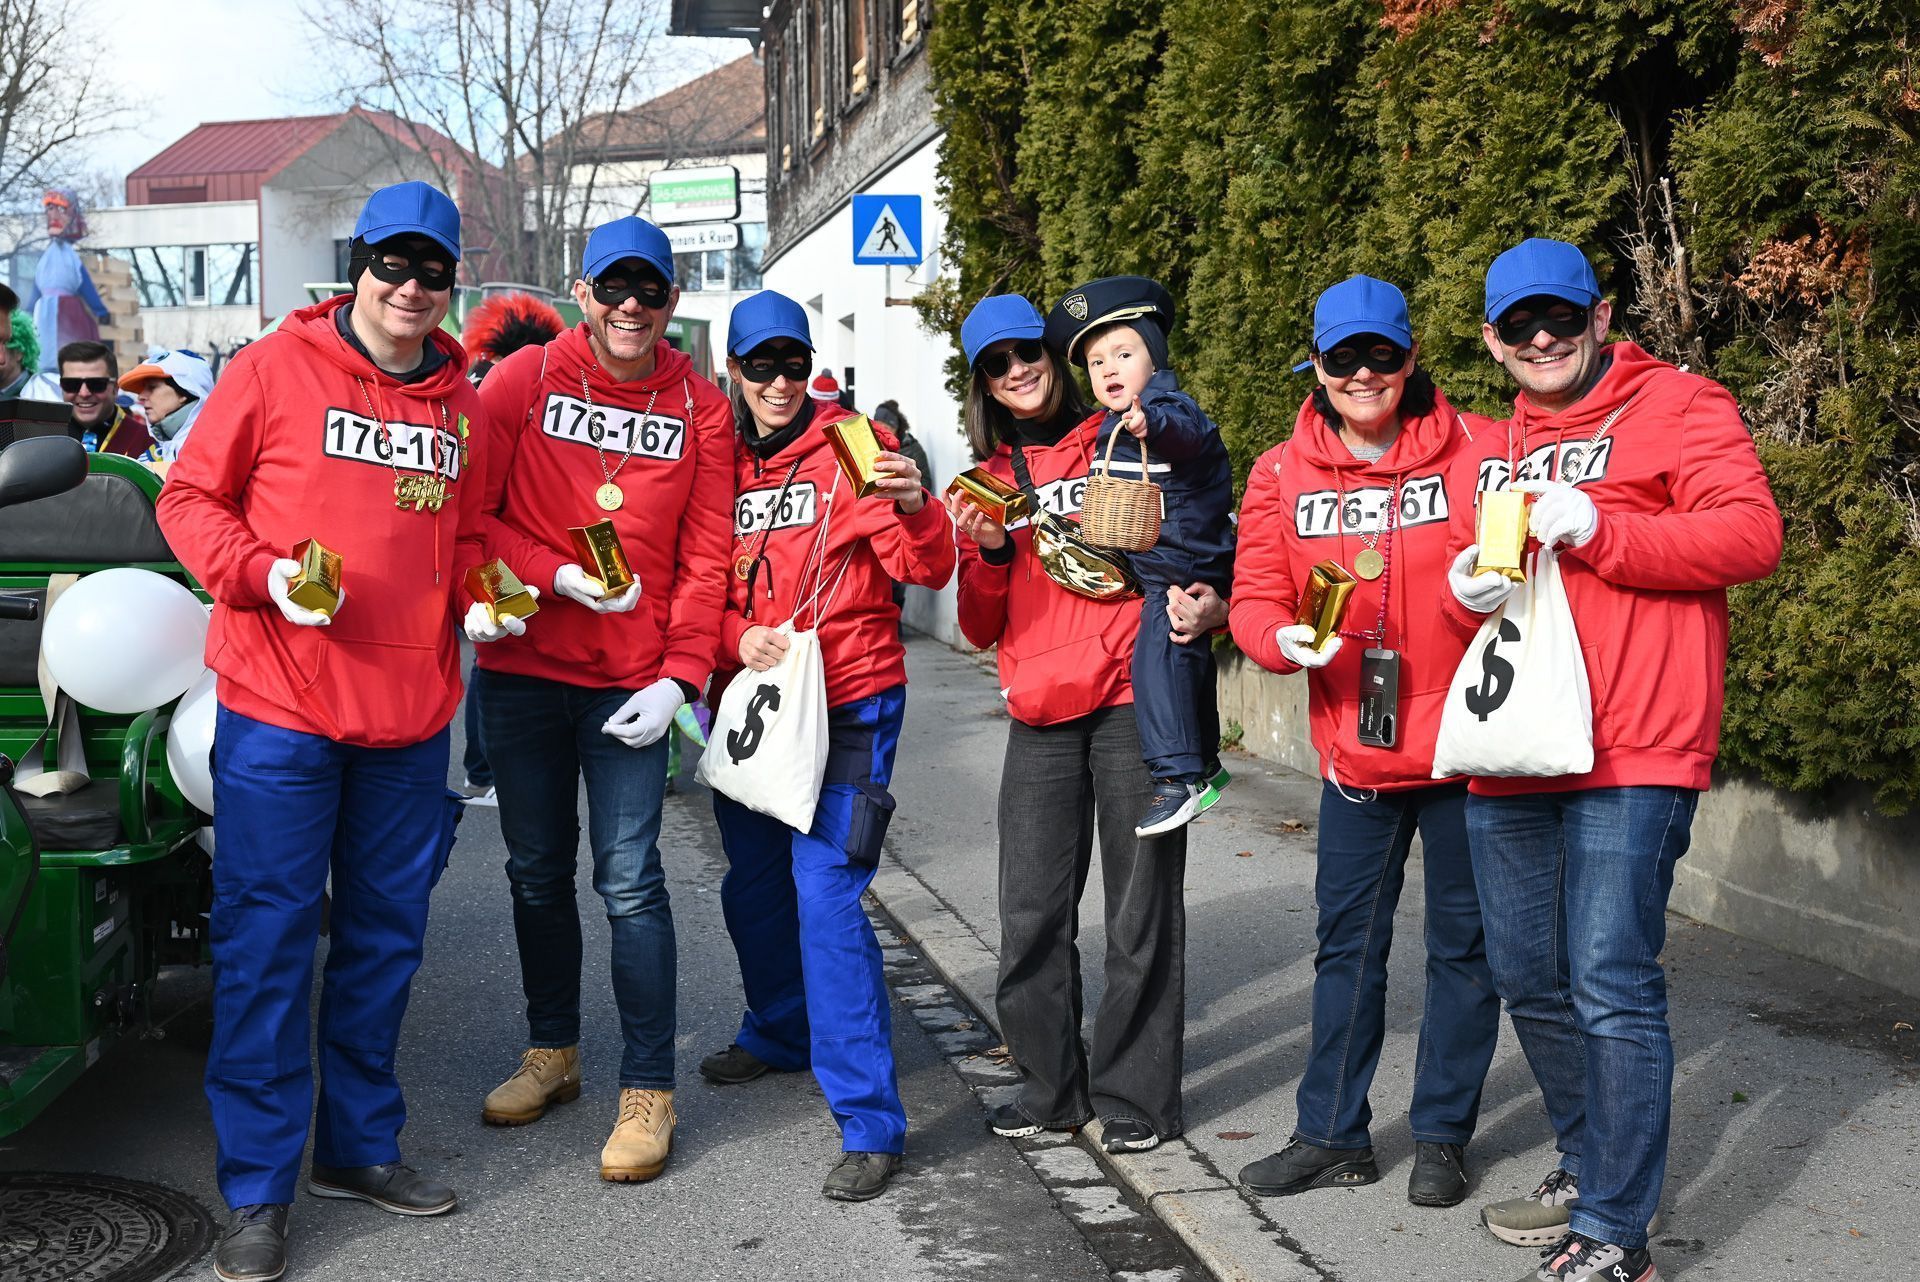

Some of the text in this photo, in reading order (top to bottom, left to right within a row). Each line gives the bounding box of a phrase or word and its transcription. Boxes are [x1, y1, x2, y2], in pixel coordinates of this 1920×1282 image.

[699, 232, 706, 244] &
[330, 416, 457, 473] 176-167
[548, 401, 682, 455] 176-167
[737, 488, 812, 530] 6-167
[1465, 617, 1521, 722] $
[726, 683, 781, 766] $
